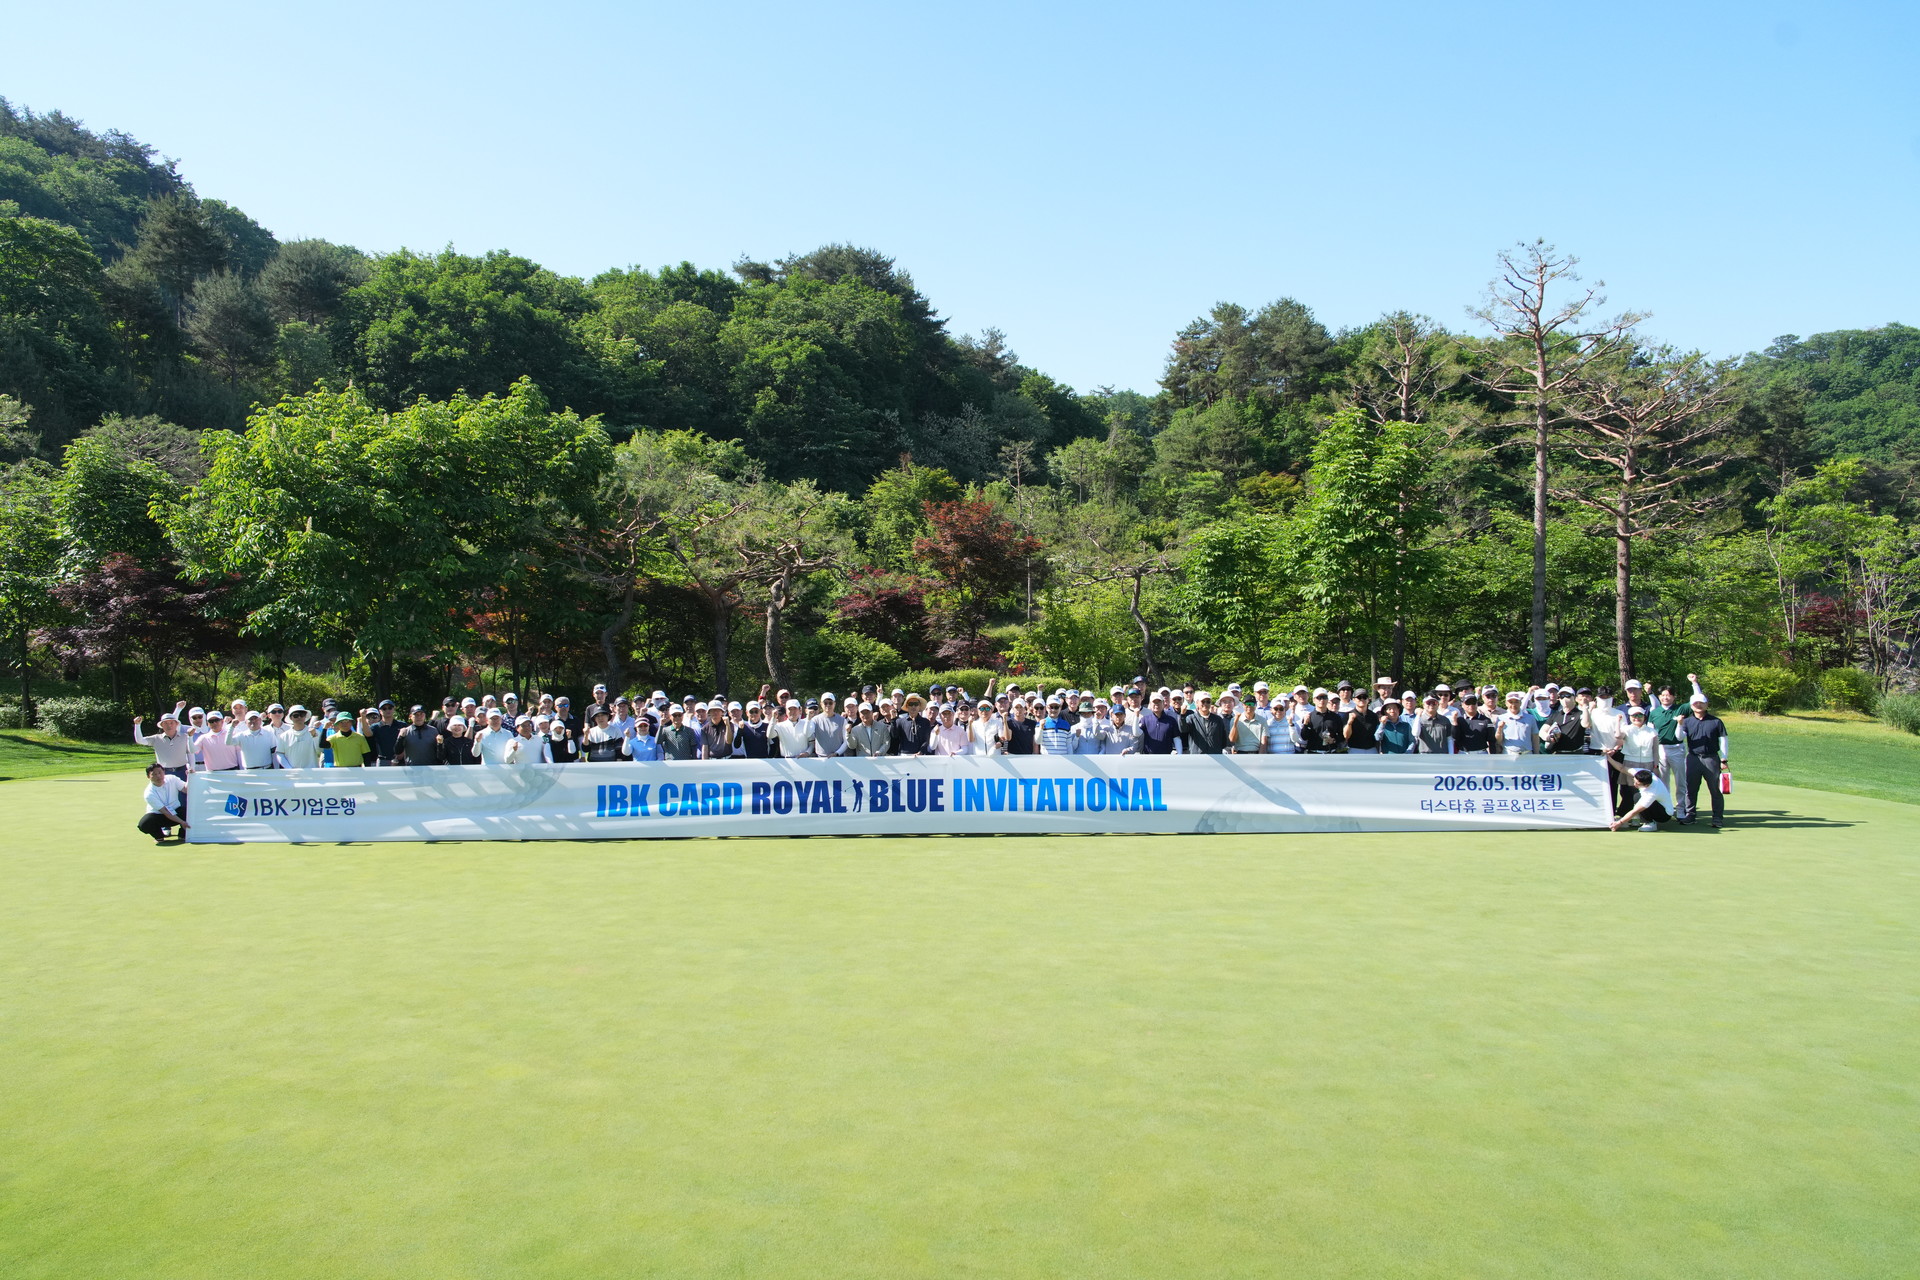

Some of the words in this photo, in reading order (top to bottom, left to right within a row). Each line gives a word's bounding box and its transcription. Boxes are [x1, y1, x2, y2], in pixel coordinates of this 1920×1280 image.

[1433, 774, 1563, 792] 2026.05.18(월)
[596, 784, 651, 818] IBK
[658, 782, 743, 817] CARD
[751, 779, 847, 815] ROYAL
[869, 778, 945, 813] BLUE
[953, 777, 1168, 812] INVITATIONAL
[1420, 798, 1477, 814] 더스타휴
[1481, 798, 1566, 814] 골프&리조트
